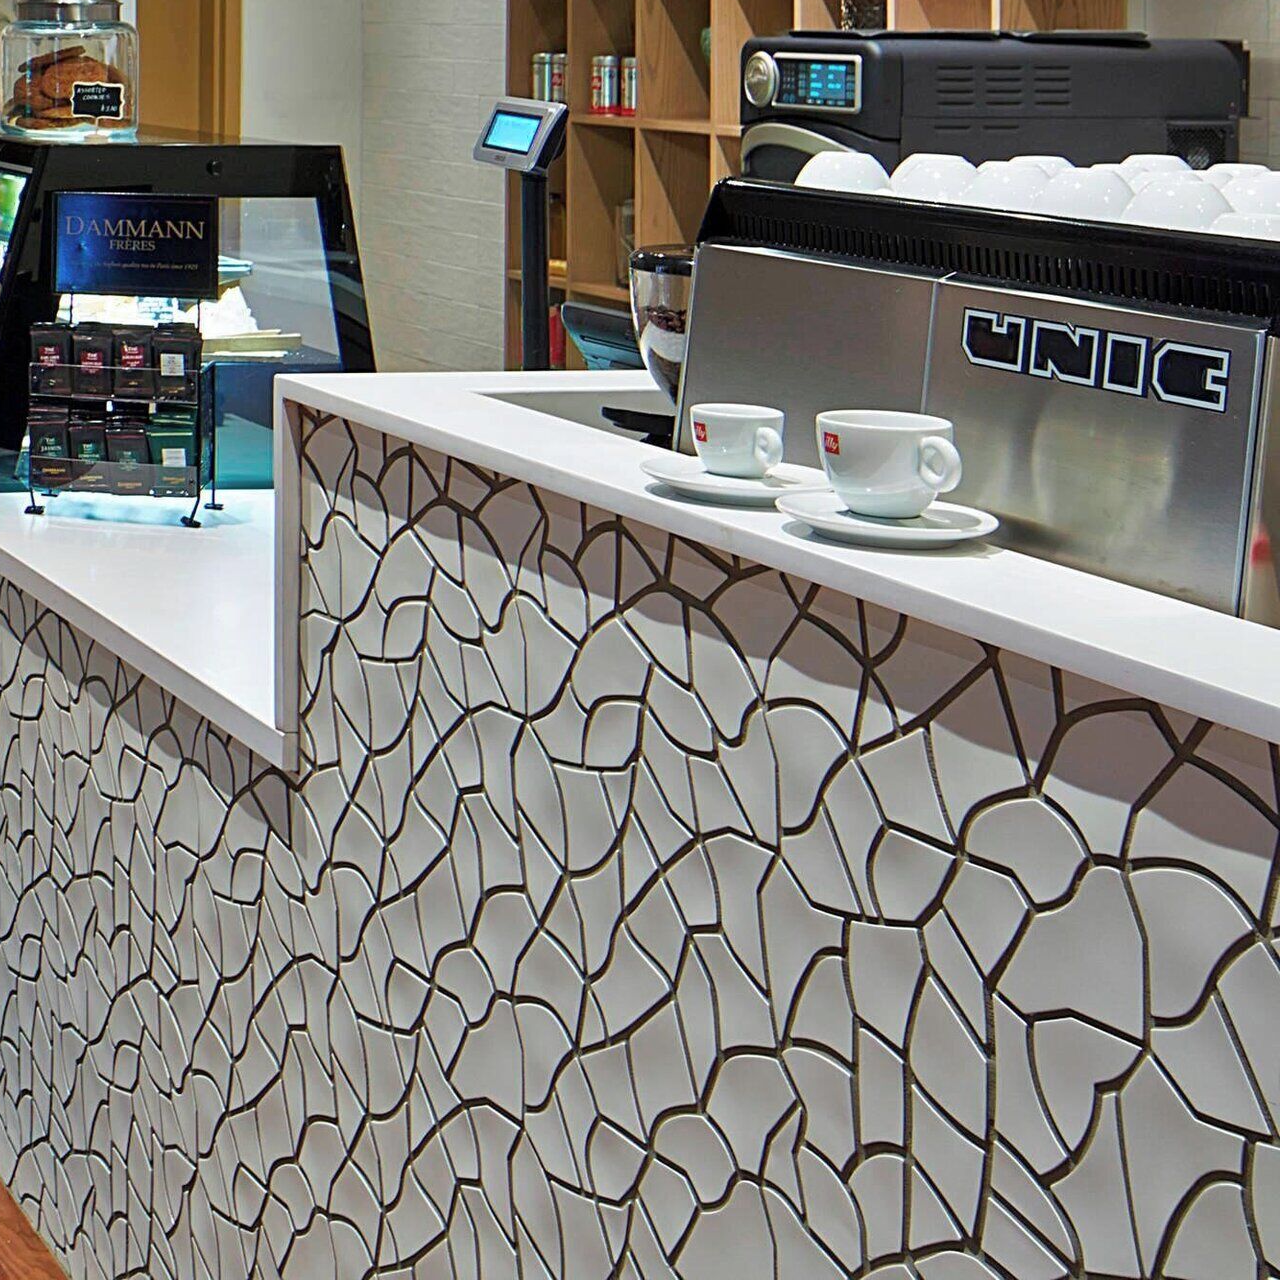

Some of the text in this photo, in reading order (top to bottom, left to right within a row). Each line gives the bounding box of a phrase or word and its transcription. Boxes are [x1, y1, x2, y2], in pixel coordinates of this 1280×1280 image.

[65, 216, 205, 240] DAMMANN
[109, 237, 156, 252] FRÈRES
[961, 307, 1233, 414] UNIC
